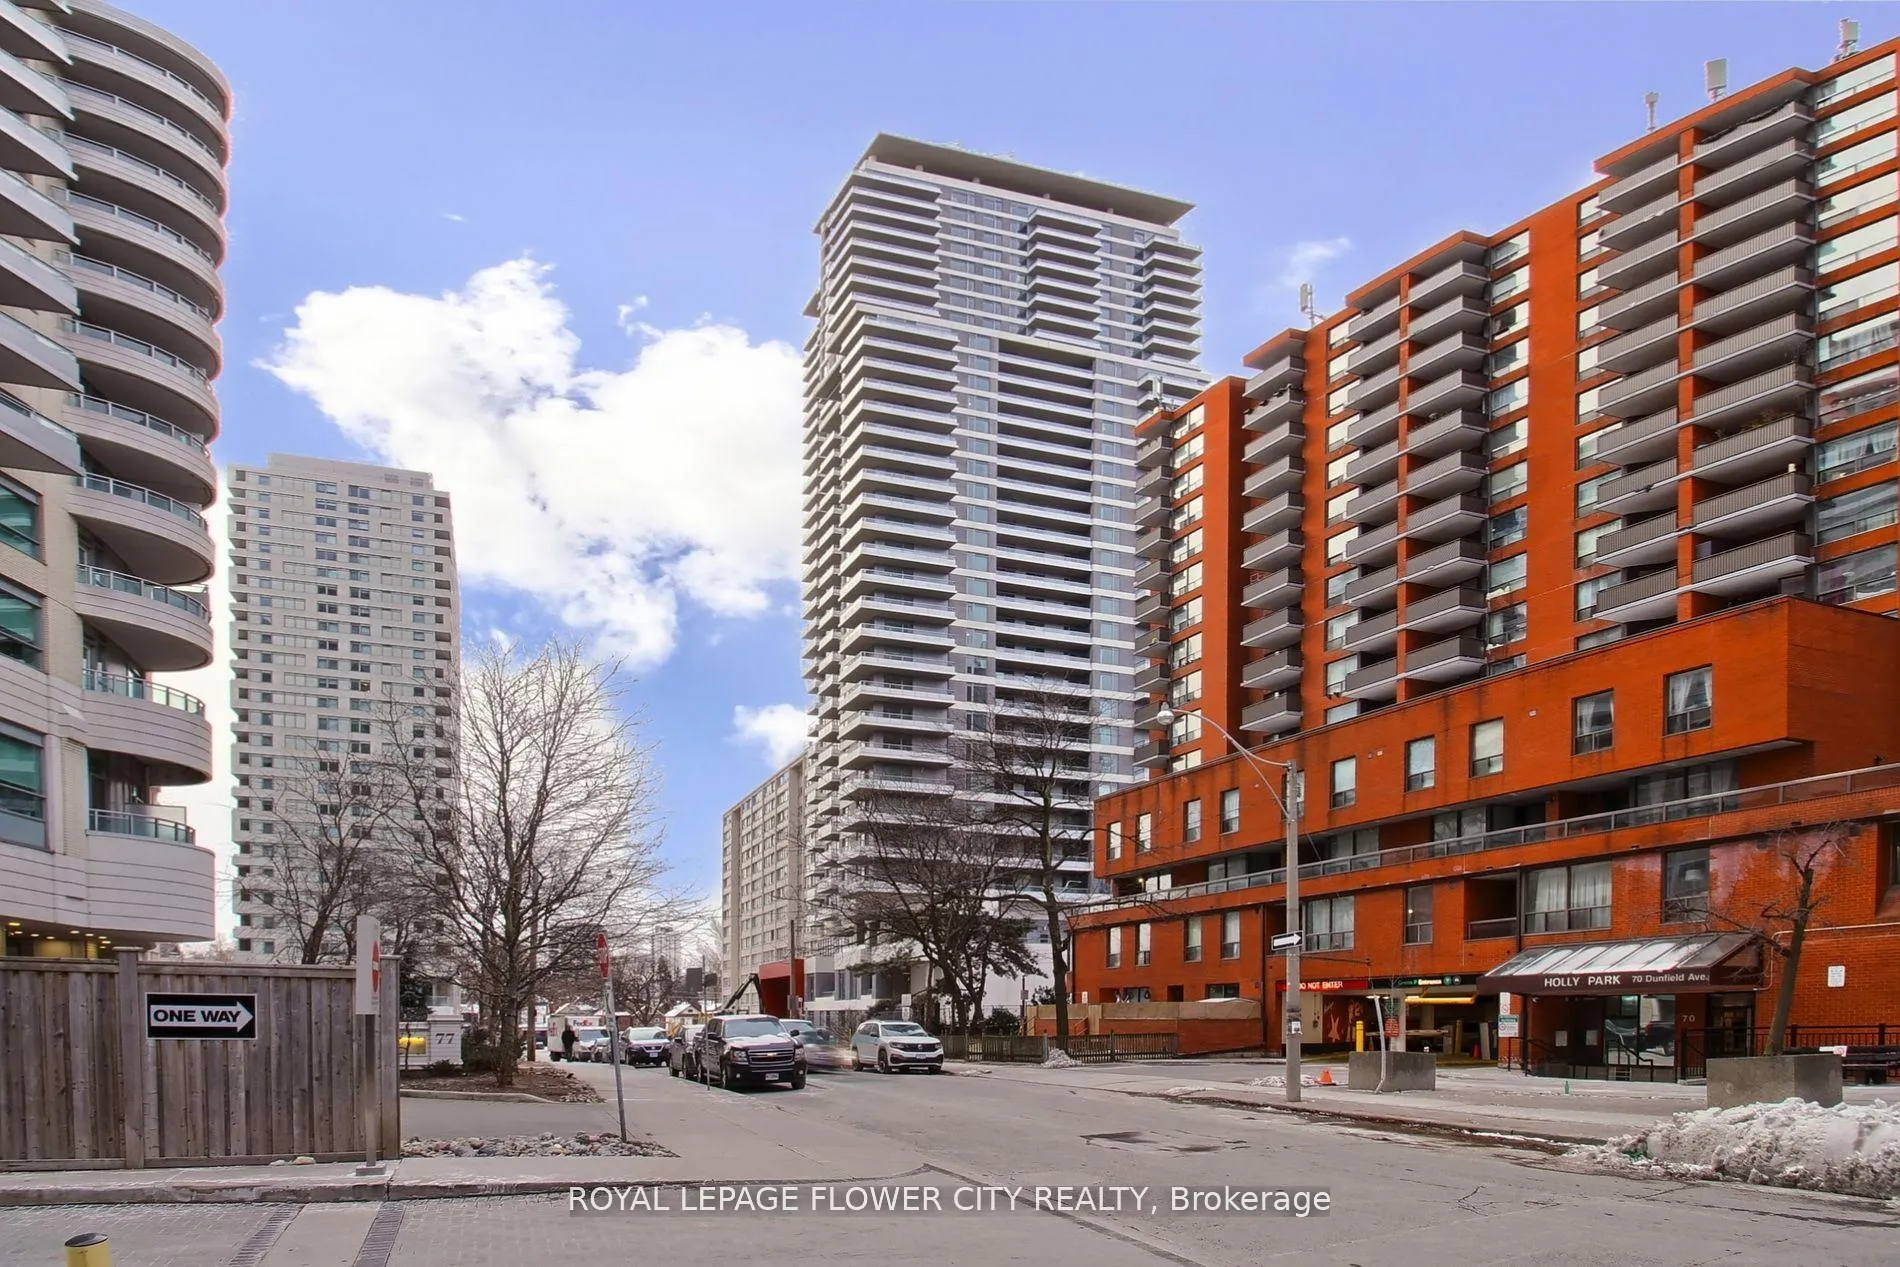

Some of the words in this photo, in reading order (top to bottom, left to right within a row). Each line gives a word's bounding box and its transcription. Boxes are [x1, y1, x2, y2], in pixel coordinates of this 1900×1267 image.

[1307, 981, 1320, 990] NOT
[1322, 981, 1344, 989] ENTER
[1544, 977, 1580, 987] HOLLY
[1588, 975, 1621, 986] PARK
[1632, 975, 1643, 983] 70
[1645, 973, 1685, 983] Dunfield
[153, 1009, 196, 1022] ONE
[201, 1010, 241, 1023] WAY
[1682, 1014, 1696, 1023] 70
[435, 1032, 455, 1044] 77
